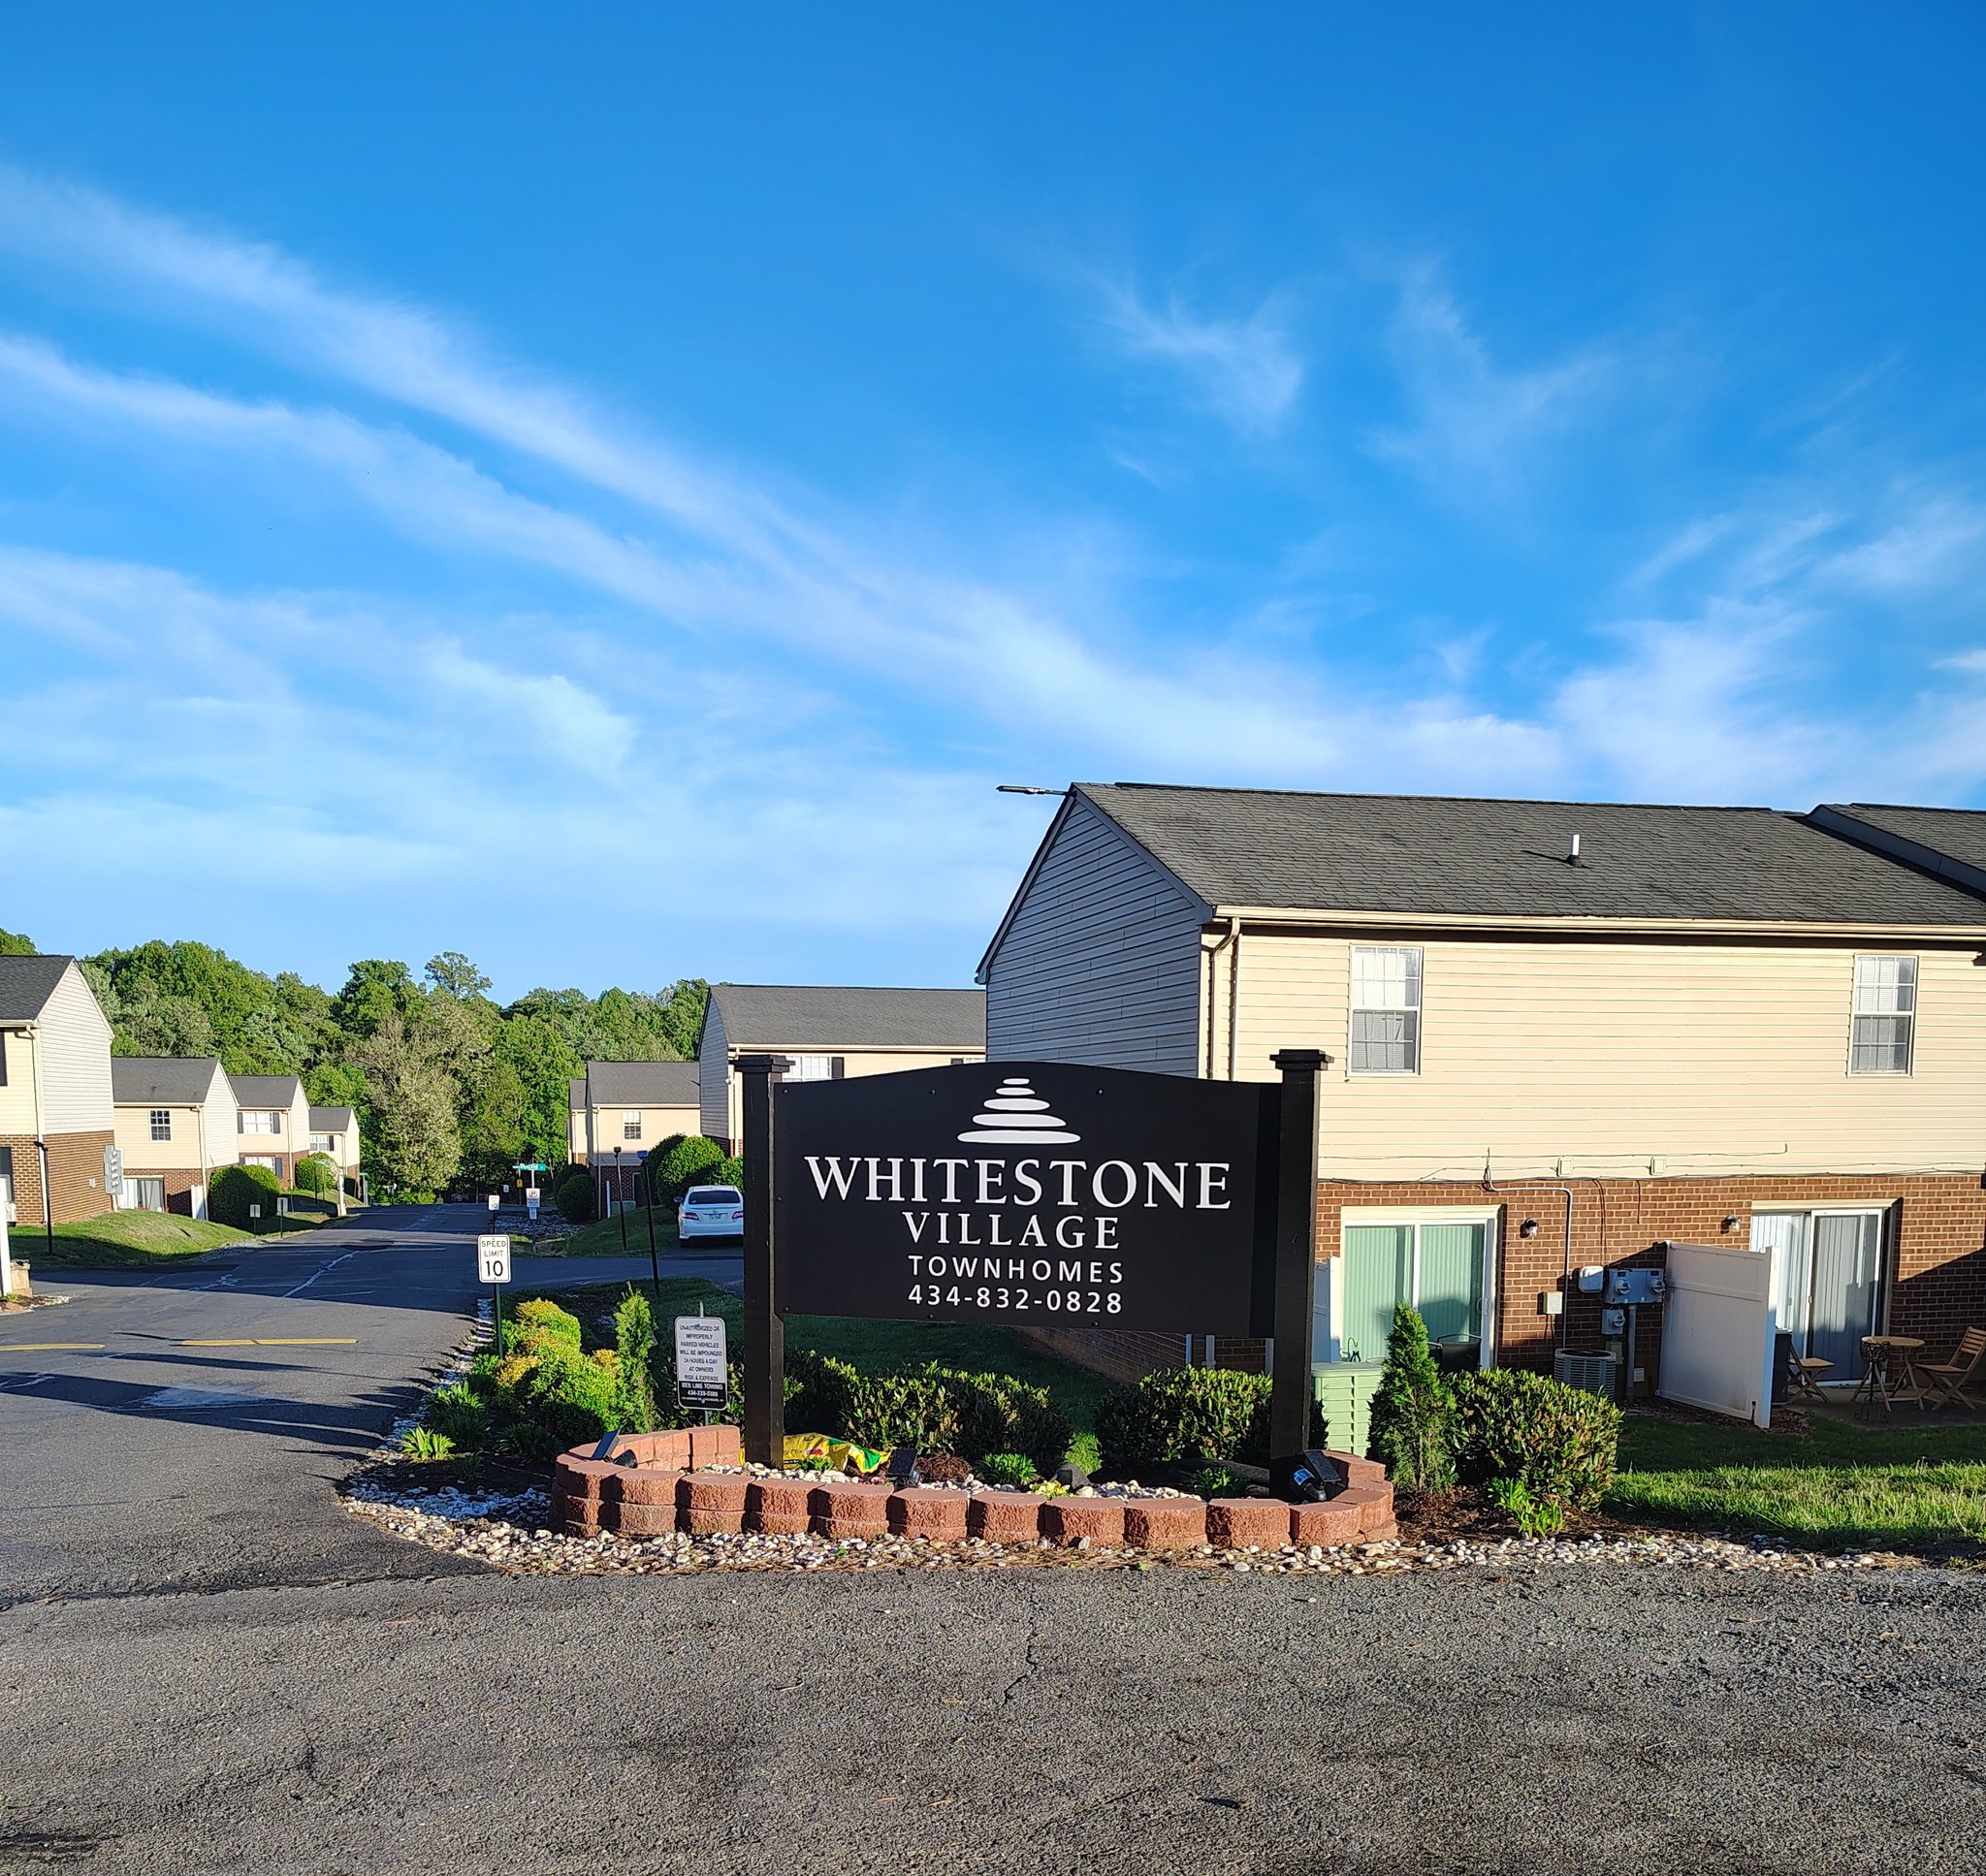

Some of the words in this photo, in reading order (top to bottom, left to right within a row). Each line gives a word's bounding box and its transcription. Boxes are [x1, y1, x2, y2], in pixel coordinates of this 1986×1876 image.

[804, 1156, 1232, 1209] WHITESTONE
[902, 1211, 1119, 1250] VILLAGE
[486, 1259, 503, 1277] 10
[908, 1255, 1123, 1284] TOWNHOMES
[908, 1284, 1122, 1314] 434-832-0828
